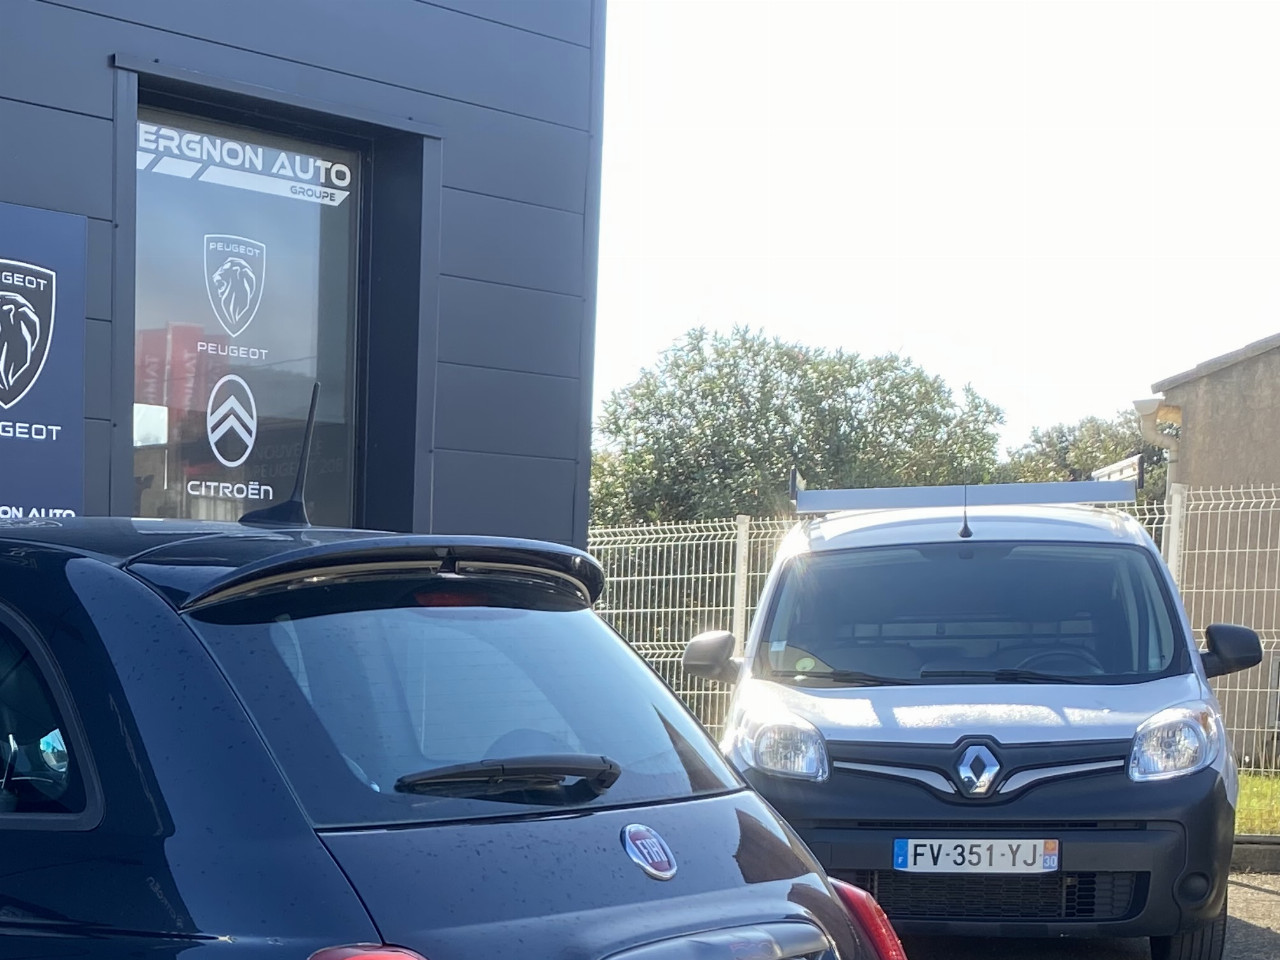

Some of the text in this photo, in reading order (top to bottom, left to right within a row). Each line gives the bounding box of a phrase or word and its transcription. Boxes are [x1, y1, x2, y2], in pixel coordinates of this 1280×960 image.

[138, 123, 352, 187] ERGNON AUTO
[290, 185, 336, 202] GROUPE
[209, 242, 261, 257] PEUGEOT
[197, 341, 268, 360] PEUGEOT
[635, 838, 669, 864] FIAT
[912, 843, 1038, 867] FV-351-YJ
[1044, 855, 1058, 867] 30
